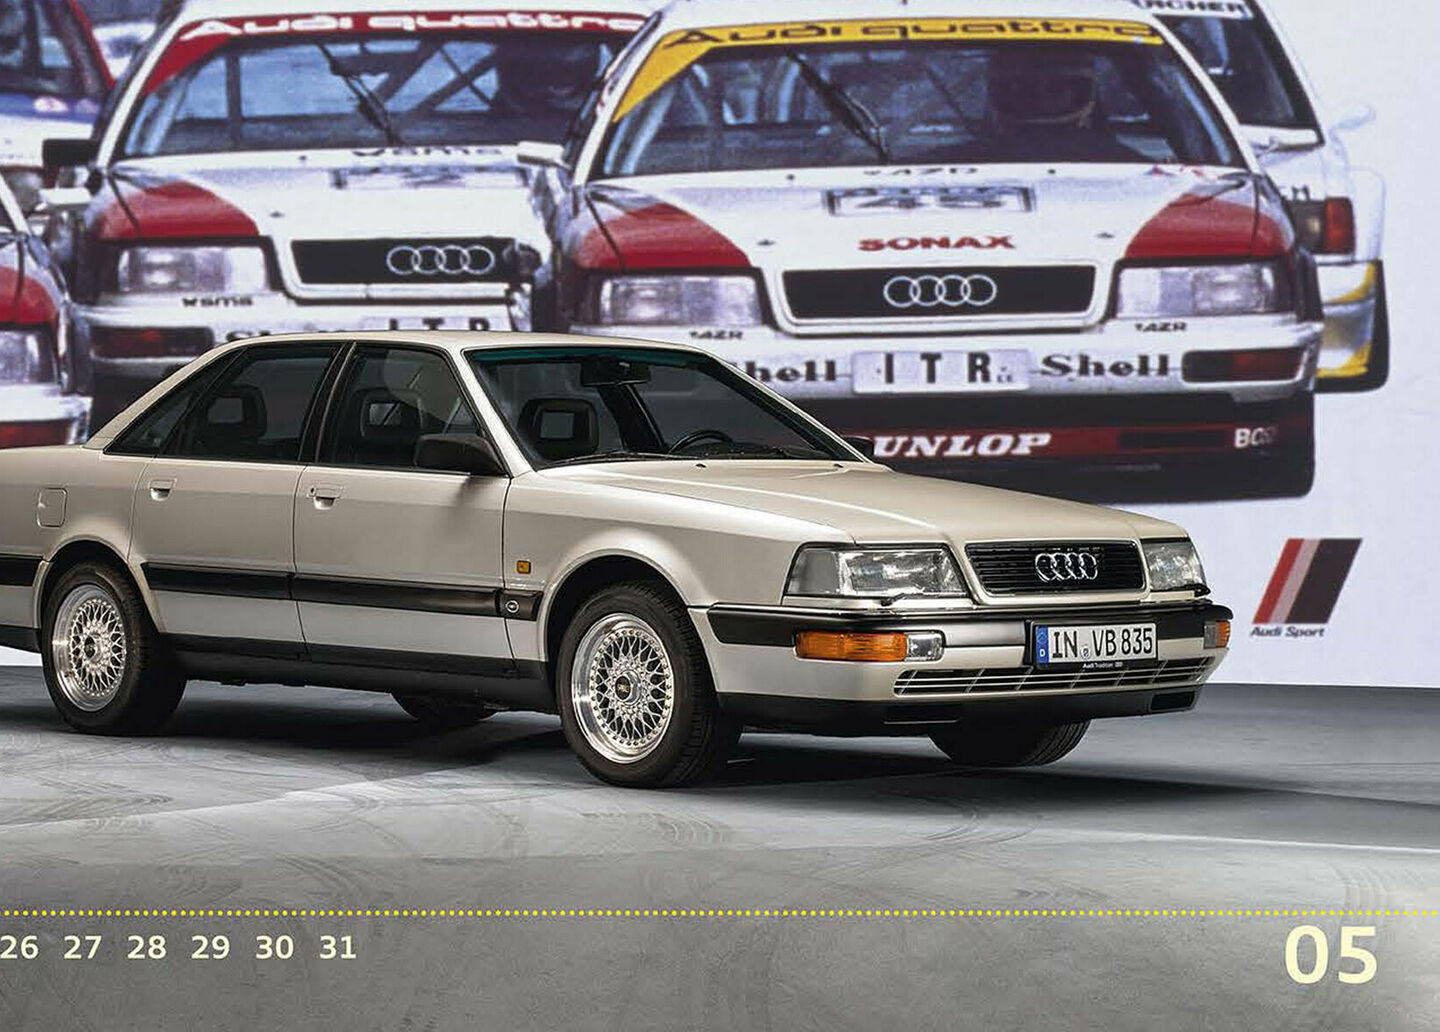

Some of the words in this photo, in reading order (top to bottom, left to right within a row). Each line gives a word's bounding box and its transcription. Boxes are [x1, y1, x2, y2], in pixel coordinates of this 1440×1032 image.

[179, 15, 354, 41] Audi
[367, 11, 645, 33] quattro
[665, 25, 842, 44] Audi
[860, 19, 1158, 40] quattro
[858, 235, 1017, 251] SONAX
[732, 359, 837, 383] hell
[1041, 354, 1169, 379] Shell
[868, 431, 1052, 458] UNLOP
[1052, 631, 1078, 659] IN
[1092, 629, 1117, 656] VB
[1121, 627, 1153, 655] 835
[1250, 626, 1282, 637] Audi
[1285, 626, 1325, 638] Sport
